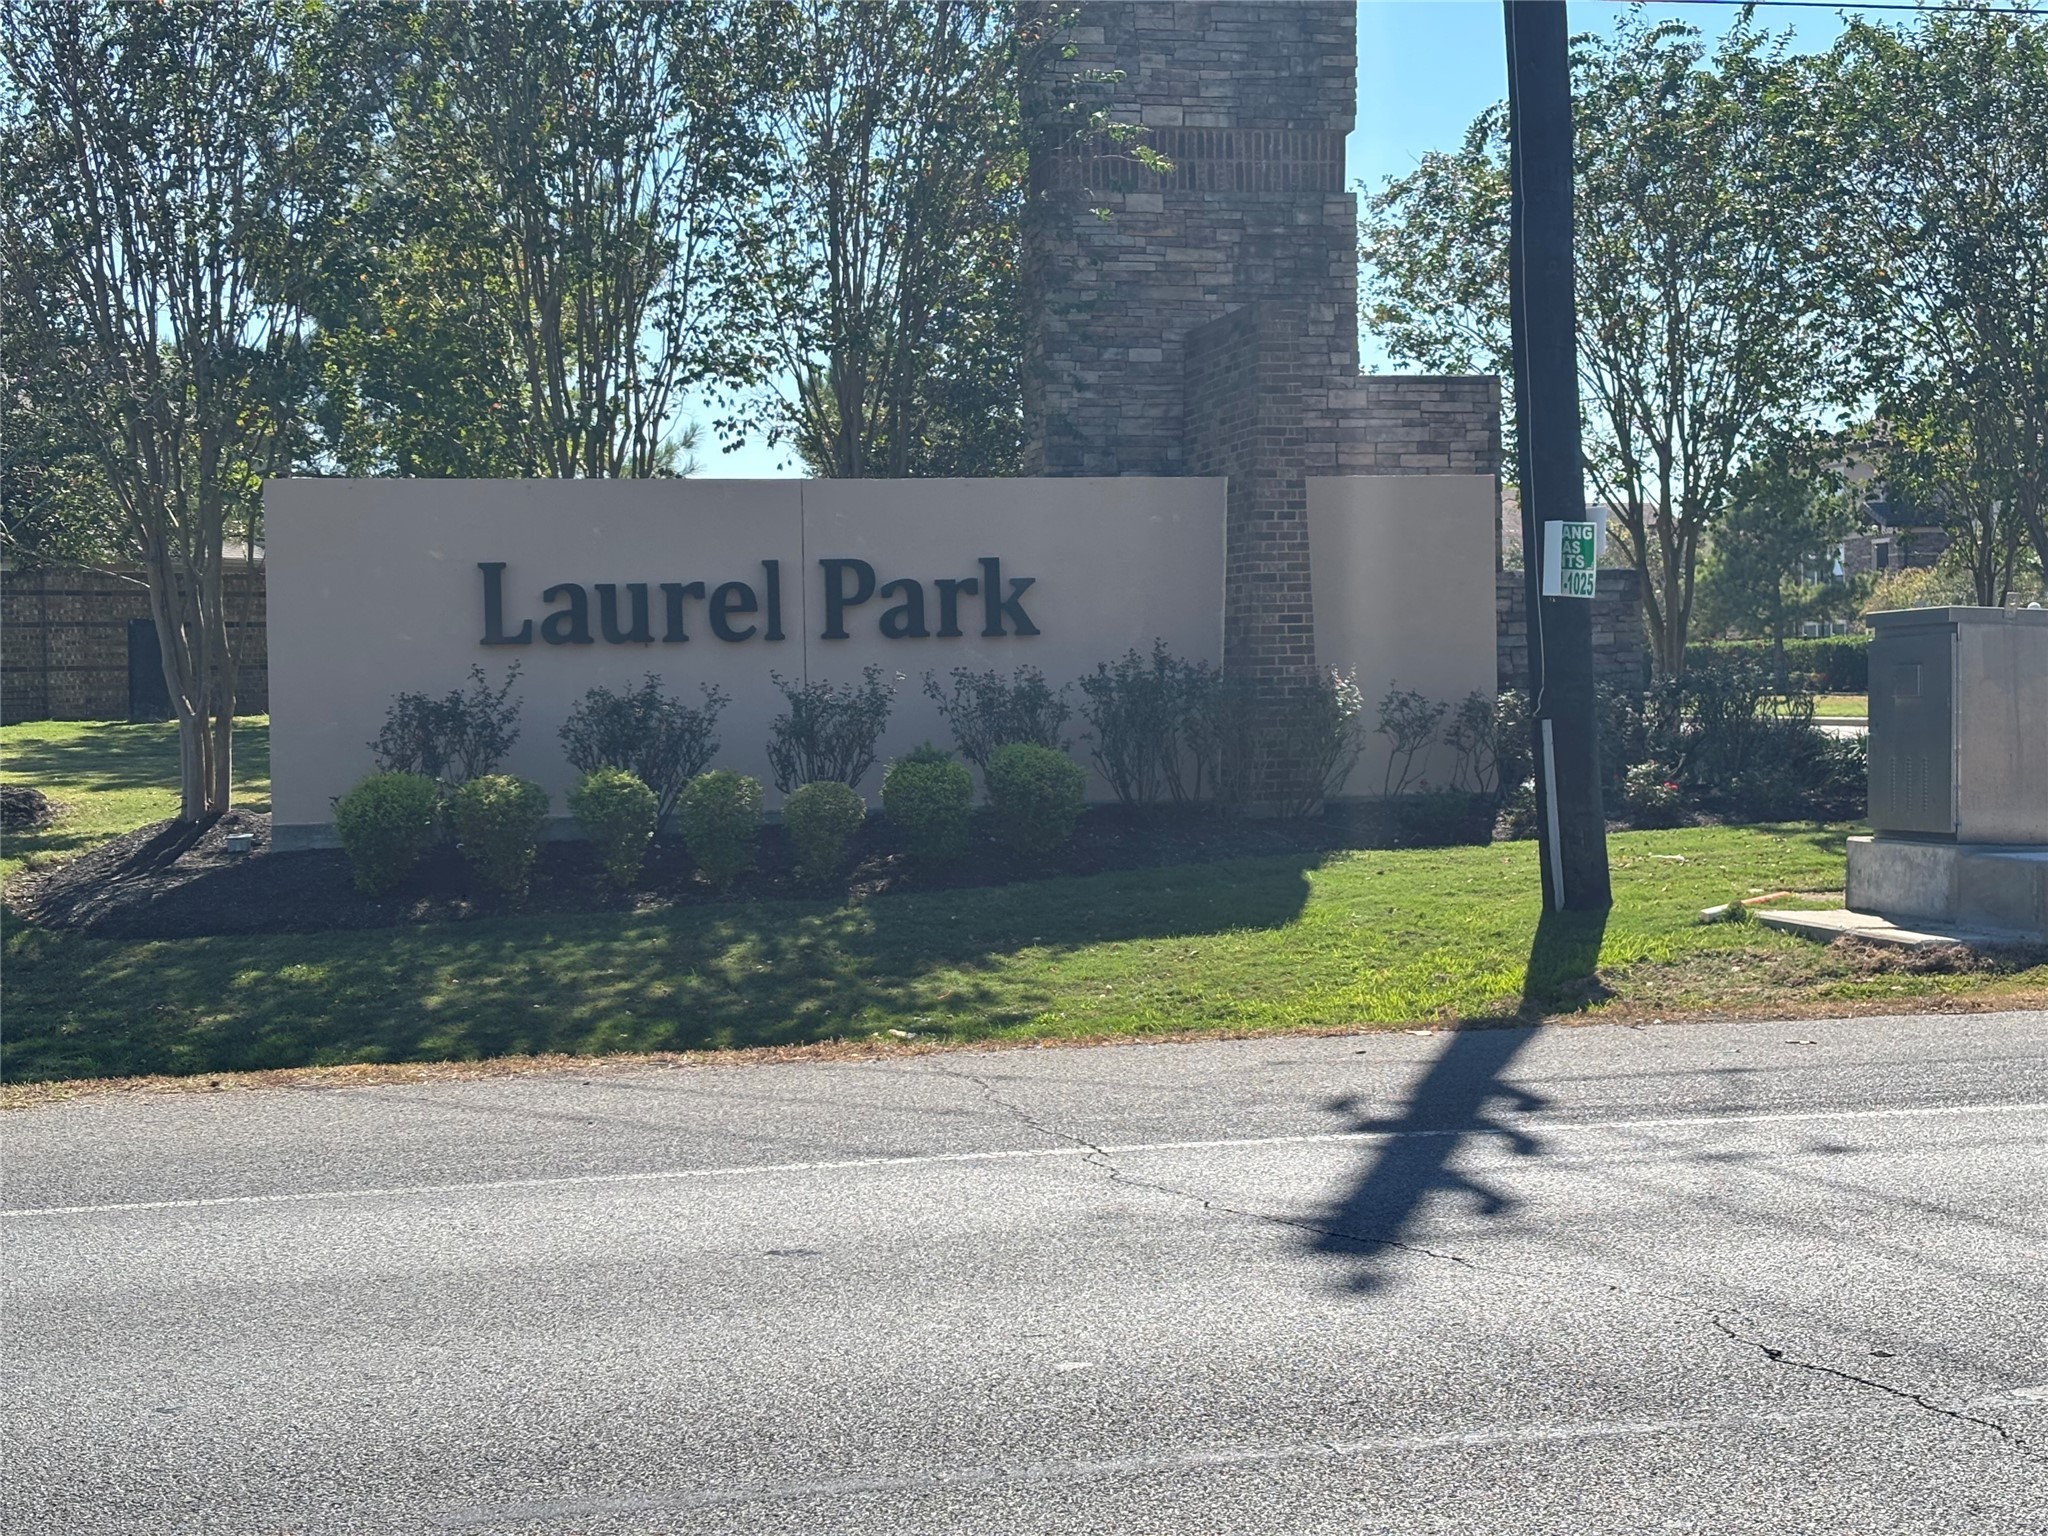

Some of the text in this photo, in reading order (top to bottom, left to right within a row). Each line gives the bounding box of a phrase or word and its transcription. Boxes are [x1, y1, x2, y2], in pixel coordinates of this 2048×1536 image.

[1562, 525, 1593, 540] ANG
[1561, 572, 1594, 596] -1025
[478, 557, 1041, 644] Laurel Park
